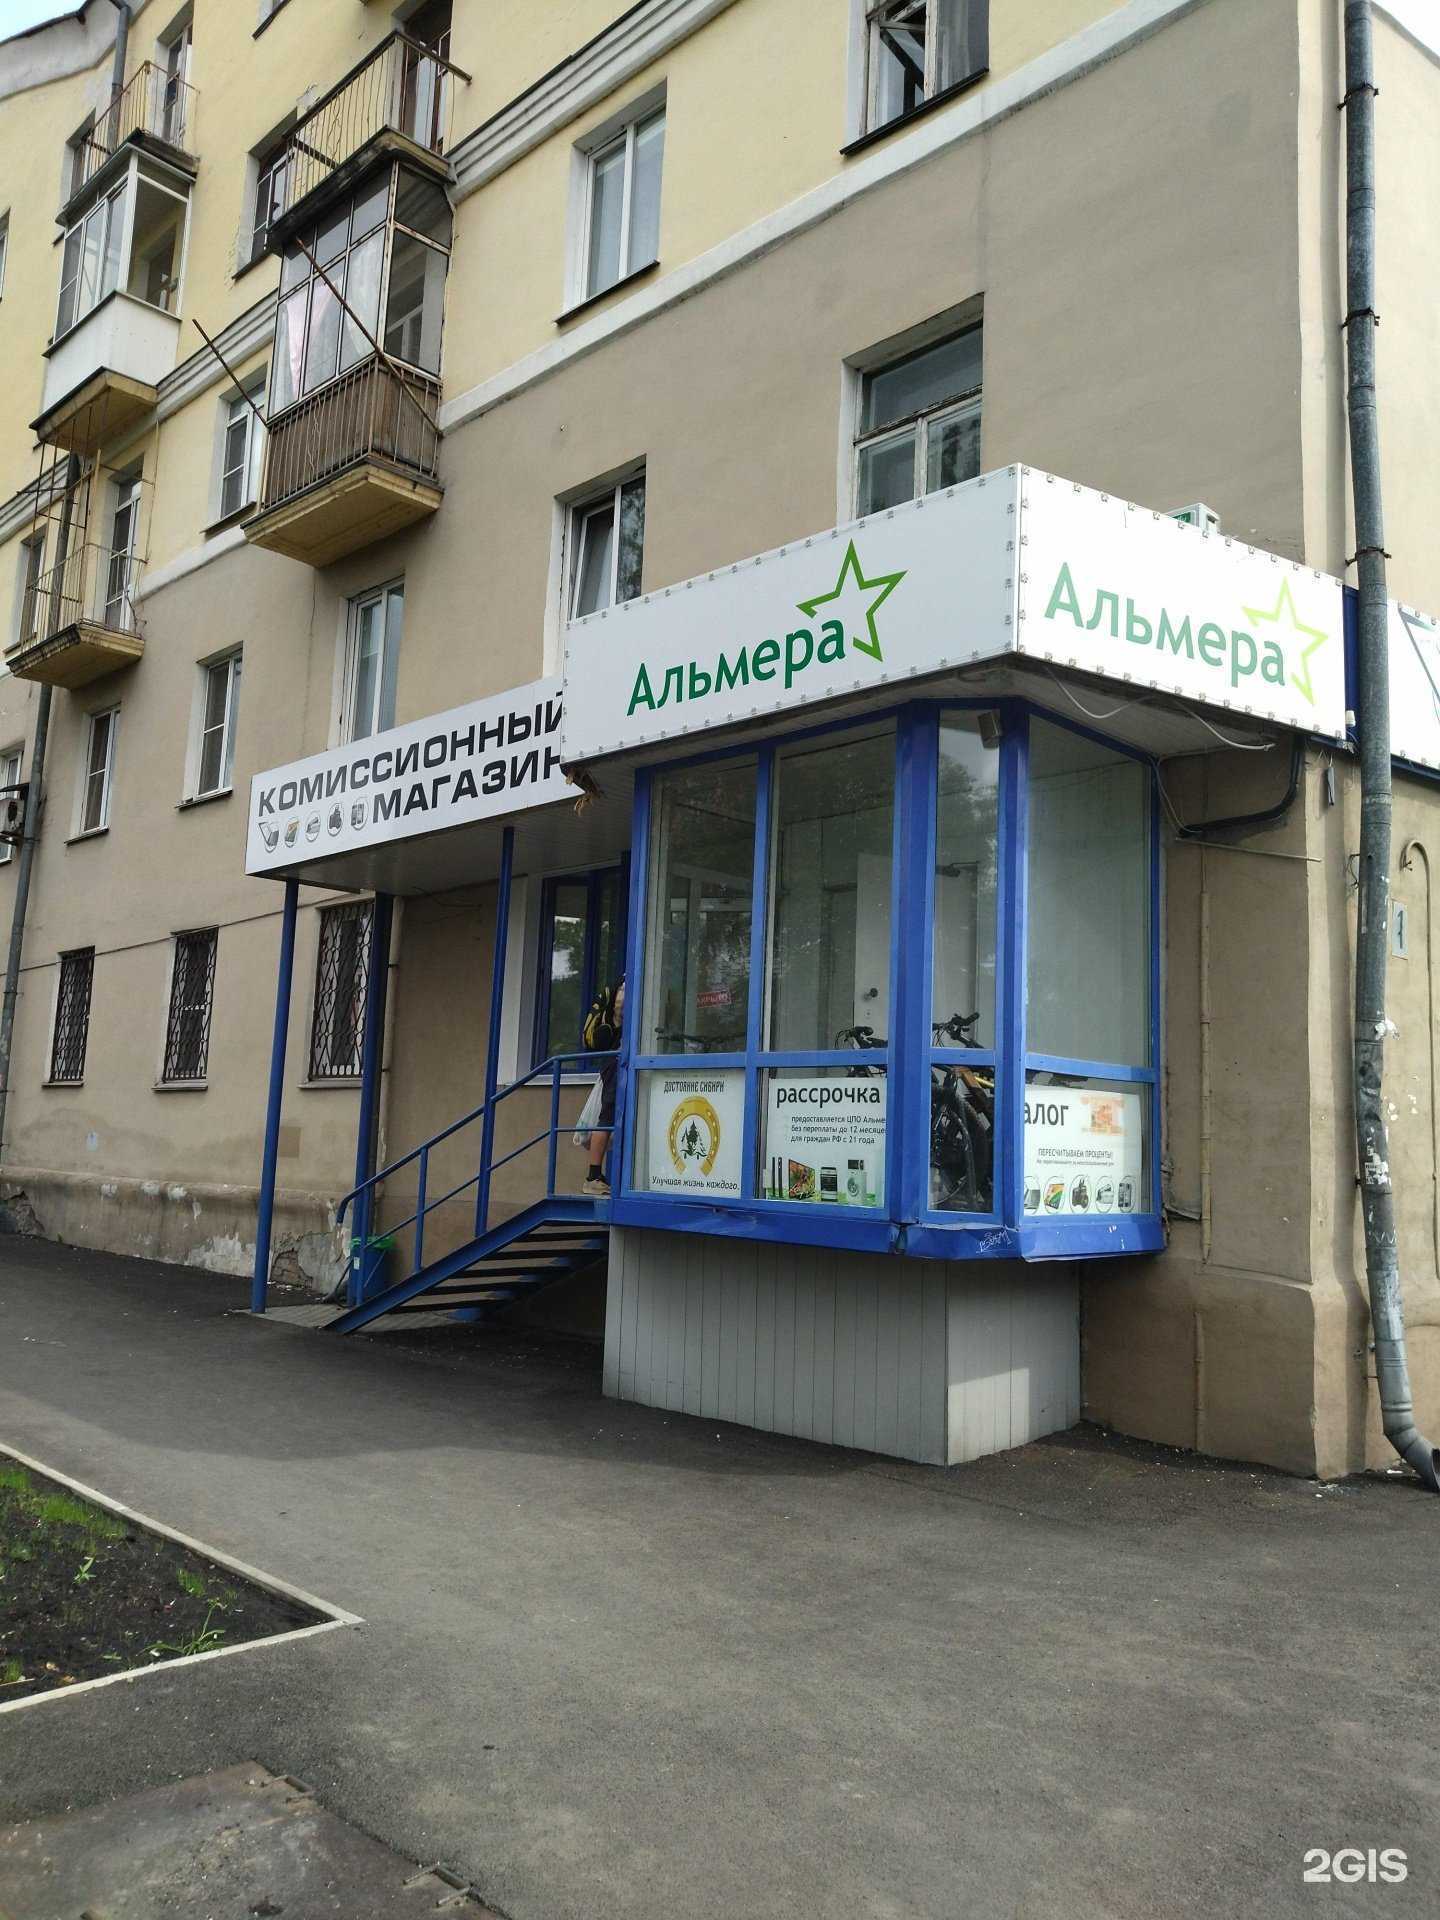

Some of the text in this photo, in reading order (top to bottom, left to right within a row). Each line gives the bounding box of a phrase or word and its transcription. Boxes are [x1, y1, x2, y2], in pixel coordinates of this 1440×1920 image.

[1044, 561, 1286, 688] Альмера
[626, 619, 846, 717] Альмера
[664, 1080, 725, 1094] ДОСТОЯНИЕ СИБИРИ
[776, 1086, 881, 1109] рассрочка
[791, 1115, 845, 1124] предоставляется
[846, 1115, 862, 1124] ЦПО
[803, 1126, 838, 1134] переплаты
[850, 1125, 858, 1133] 12
[791, 1135, 803, 1143] для
[804, 1136, 831, 1144] граждан
[832, 1135, 842, 1143] РФ
[848, 1135, 857, 1143] 21
[858, 1136, 875, 1144] года
[652, 1175, 682, 1186] Улучшая
[683, 1179, 705, 1188] жизнь
